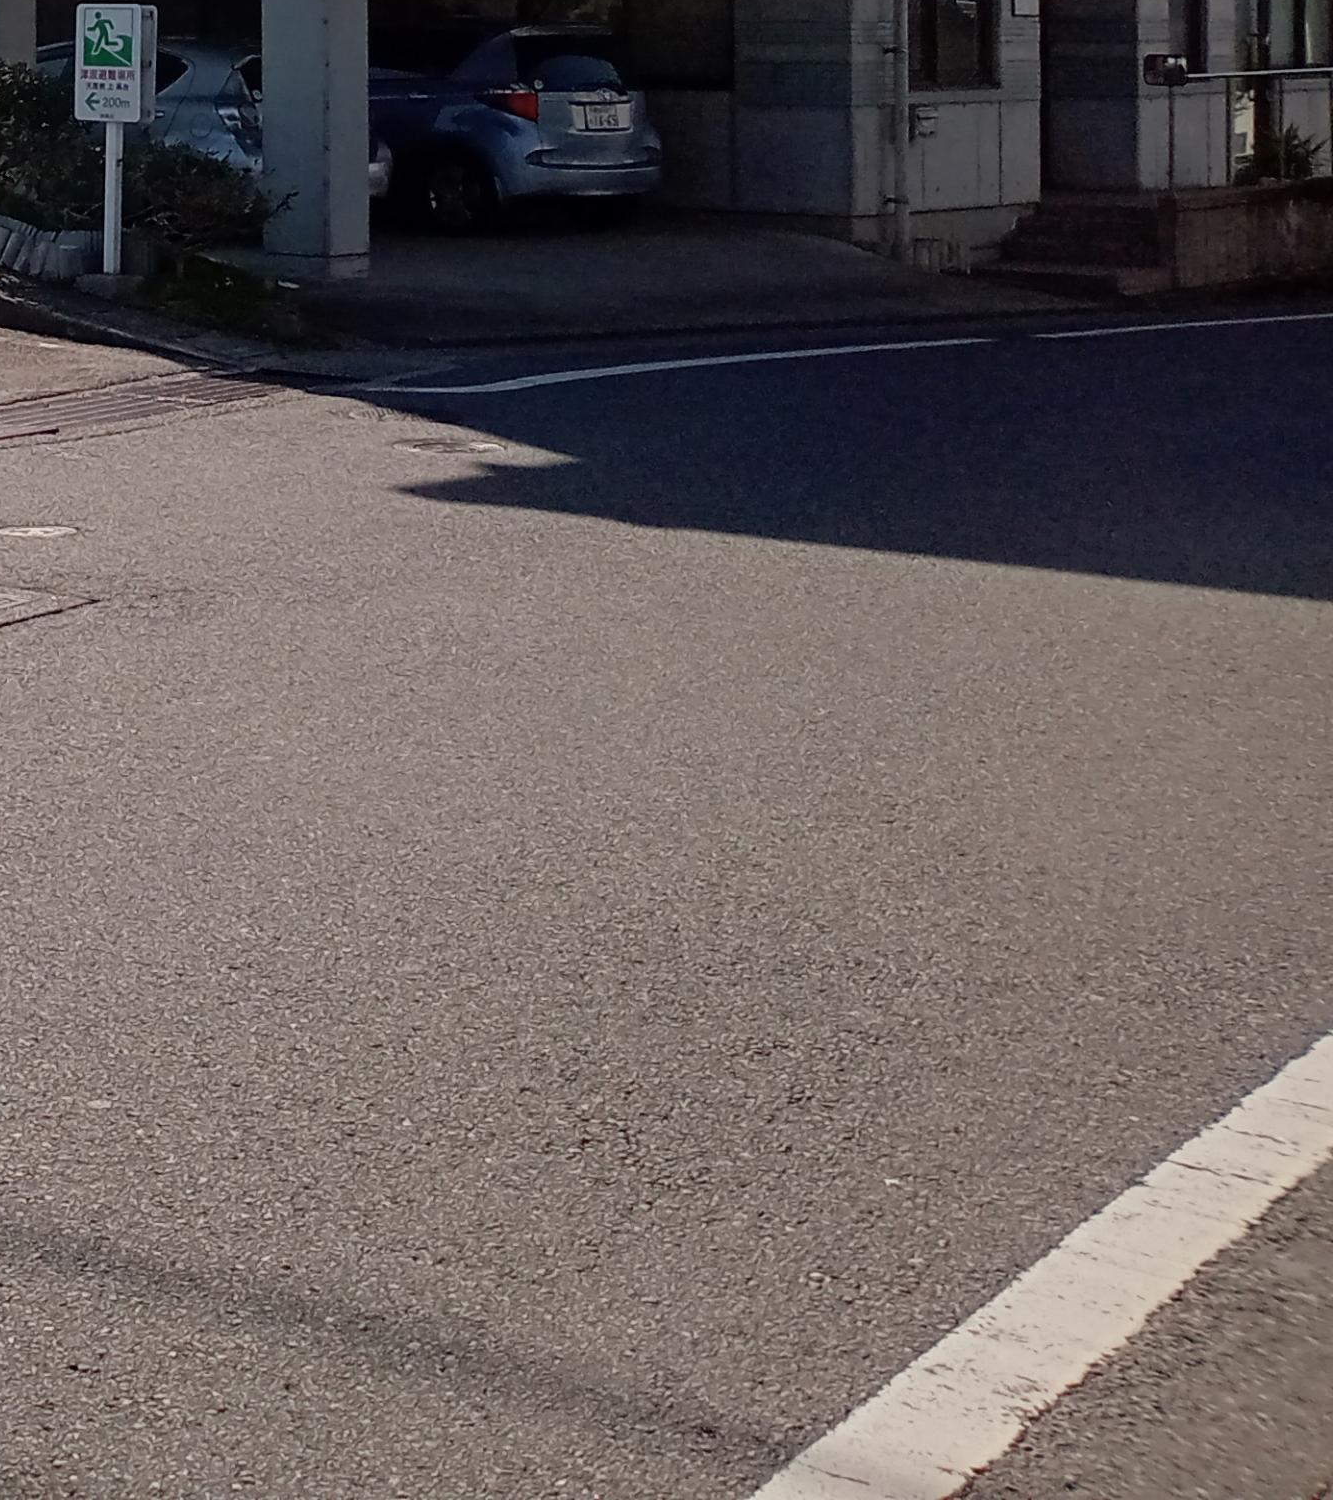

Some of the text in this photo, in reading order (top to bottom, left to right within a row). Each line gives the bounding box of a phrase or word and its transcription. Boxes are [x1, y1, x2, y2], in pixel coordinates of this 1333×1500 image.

[80, 68, 135, 81] 津波避難場所
[102, 96, 131, 108] 200m
